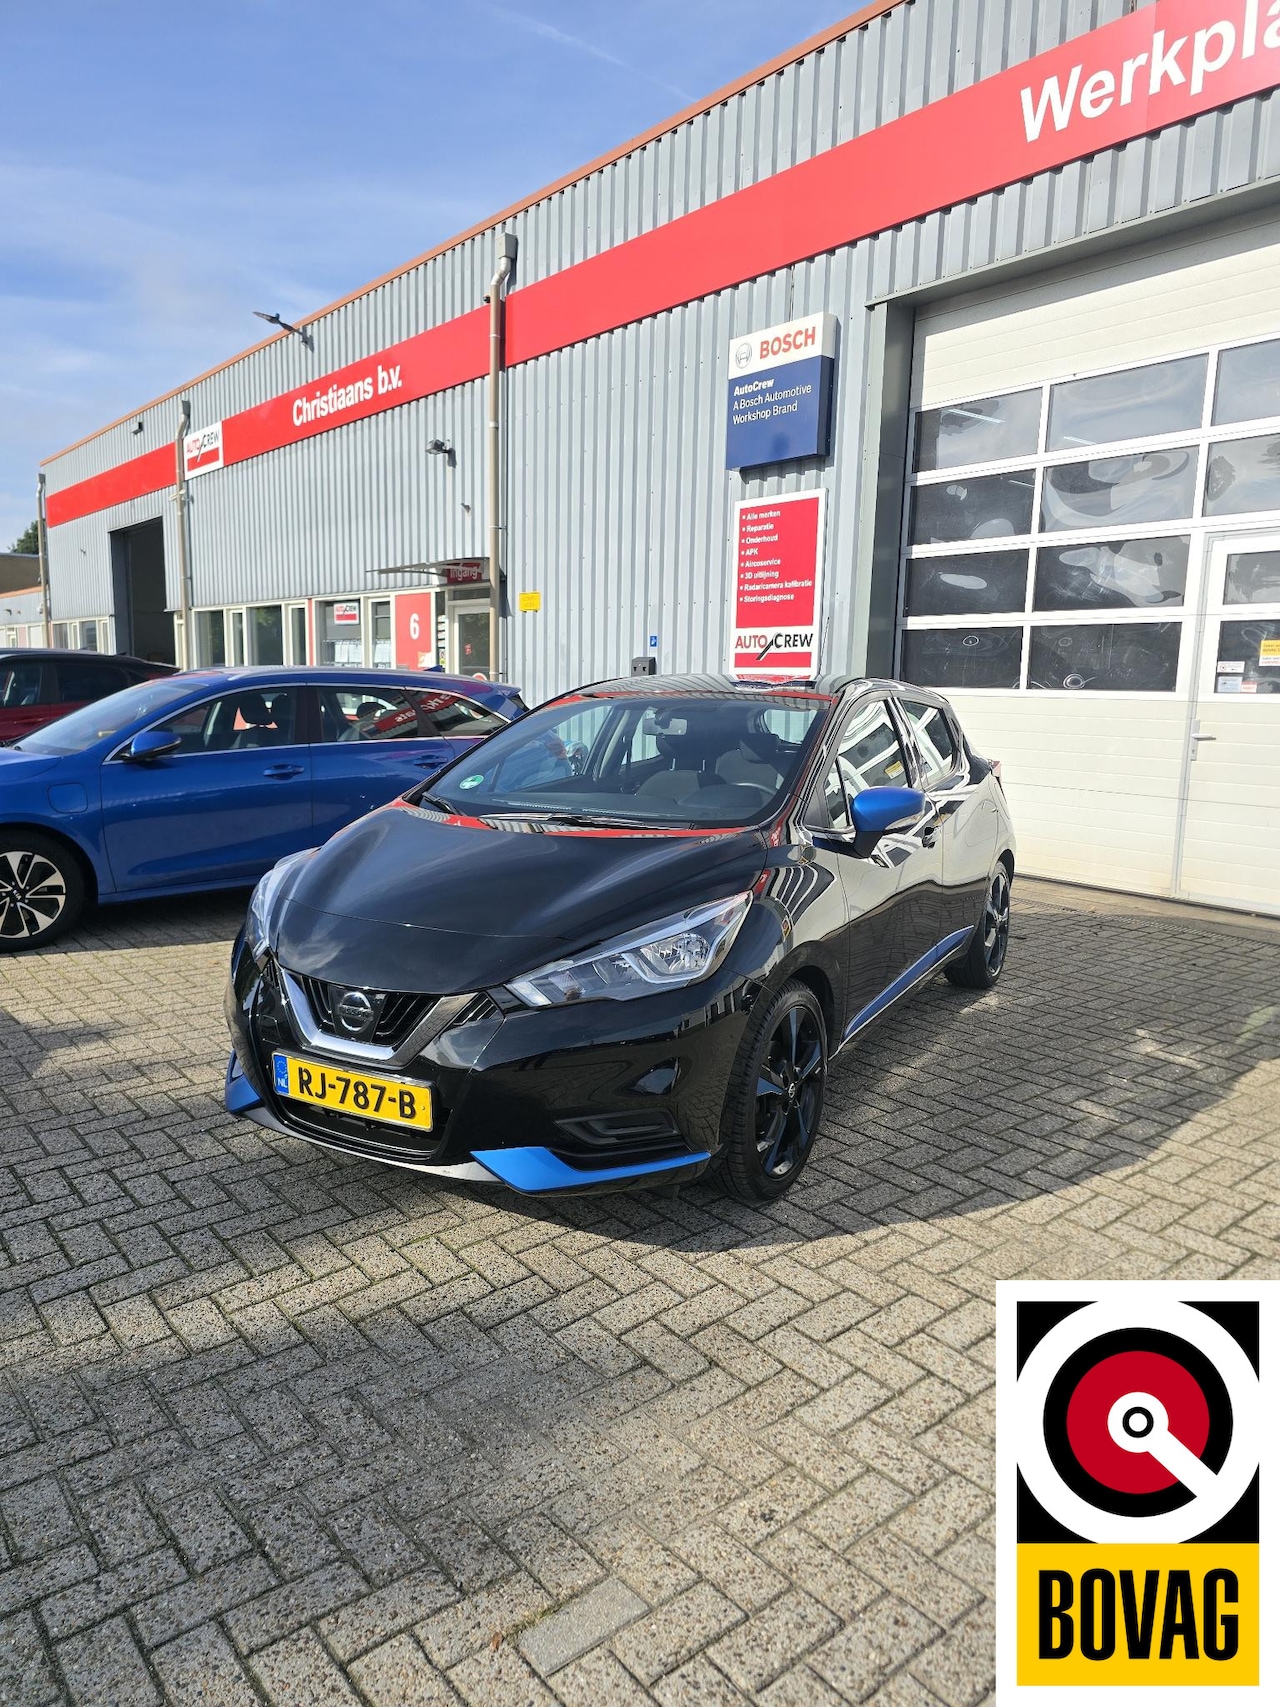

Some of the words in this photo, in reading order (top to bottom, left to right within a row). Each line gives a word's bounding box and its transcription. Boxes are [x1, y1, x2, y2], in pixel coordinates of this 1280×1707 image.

[759, 326, 816, 360] BOSCH
[733, 378, 775, 396] AutoCrew
[292, 376, 374, 427] Christiaans
[377, 364, 403, 395] b.v.
[732, 400, 739, 412] A
[739, 394, 763, 410] Bosch
[764, 383, 812, 403] Automotive
[732, 408, 771, 425] Workshop
[772, 400, 798, 416] Brand
[746, 512, 758, 521] Alle
[758, 510, 781, 519] merken
[746, 522, 774, 533] Reparatie
[745, 533, 779, 544] Onderhoud
[745, 548, 759, 556] APK
[744, 558, 781, 568] Aircoservice
[744, 571, 753, 580] 3D
[743, 594, 795, 604] Storingsdiagnose
[409, 612, 420, 640] 6
[734, 634, 768, 649] AUTO
[774, 633, 814, 649] CREW
[276, 1077, 288, 1089] NL
[297, 1066, 417, 1120] RJ-787-B
